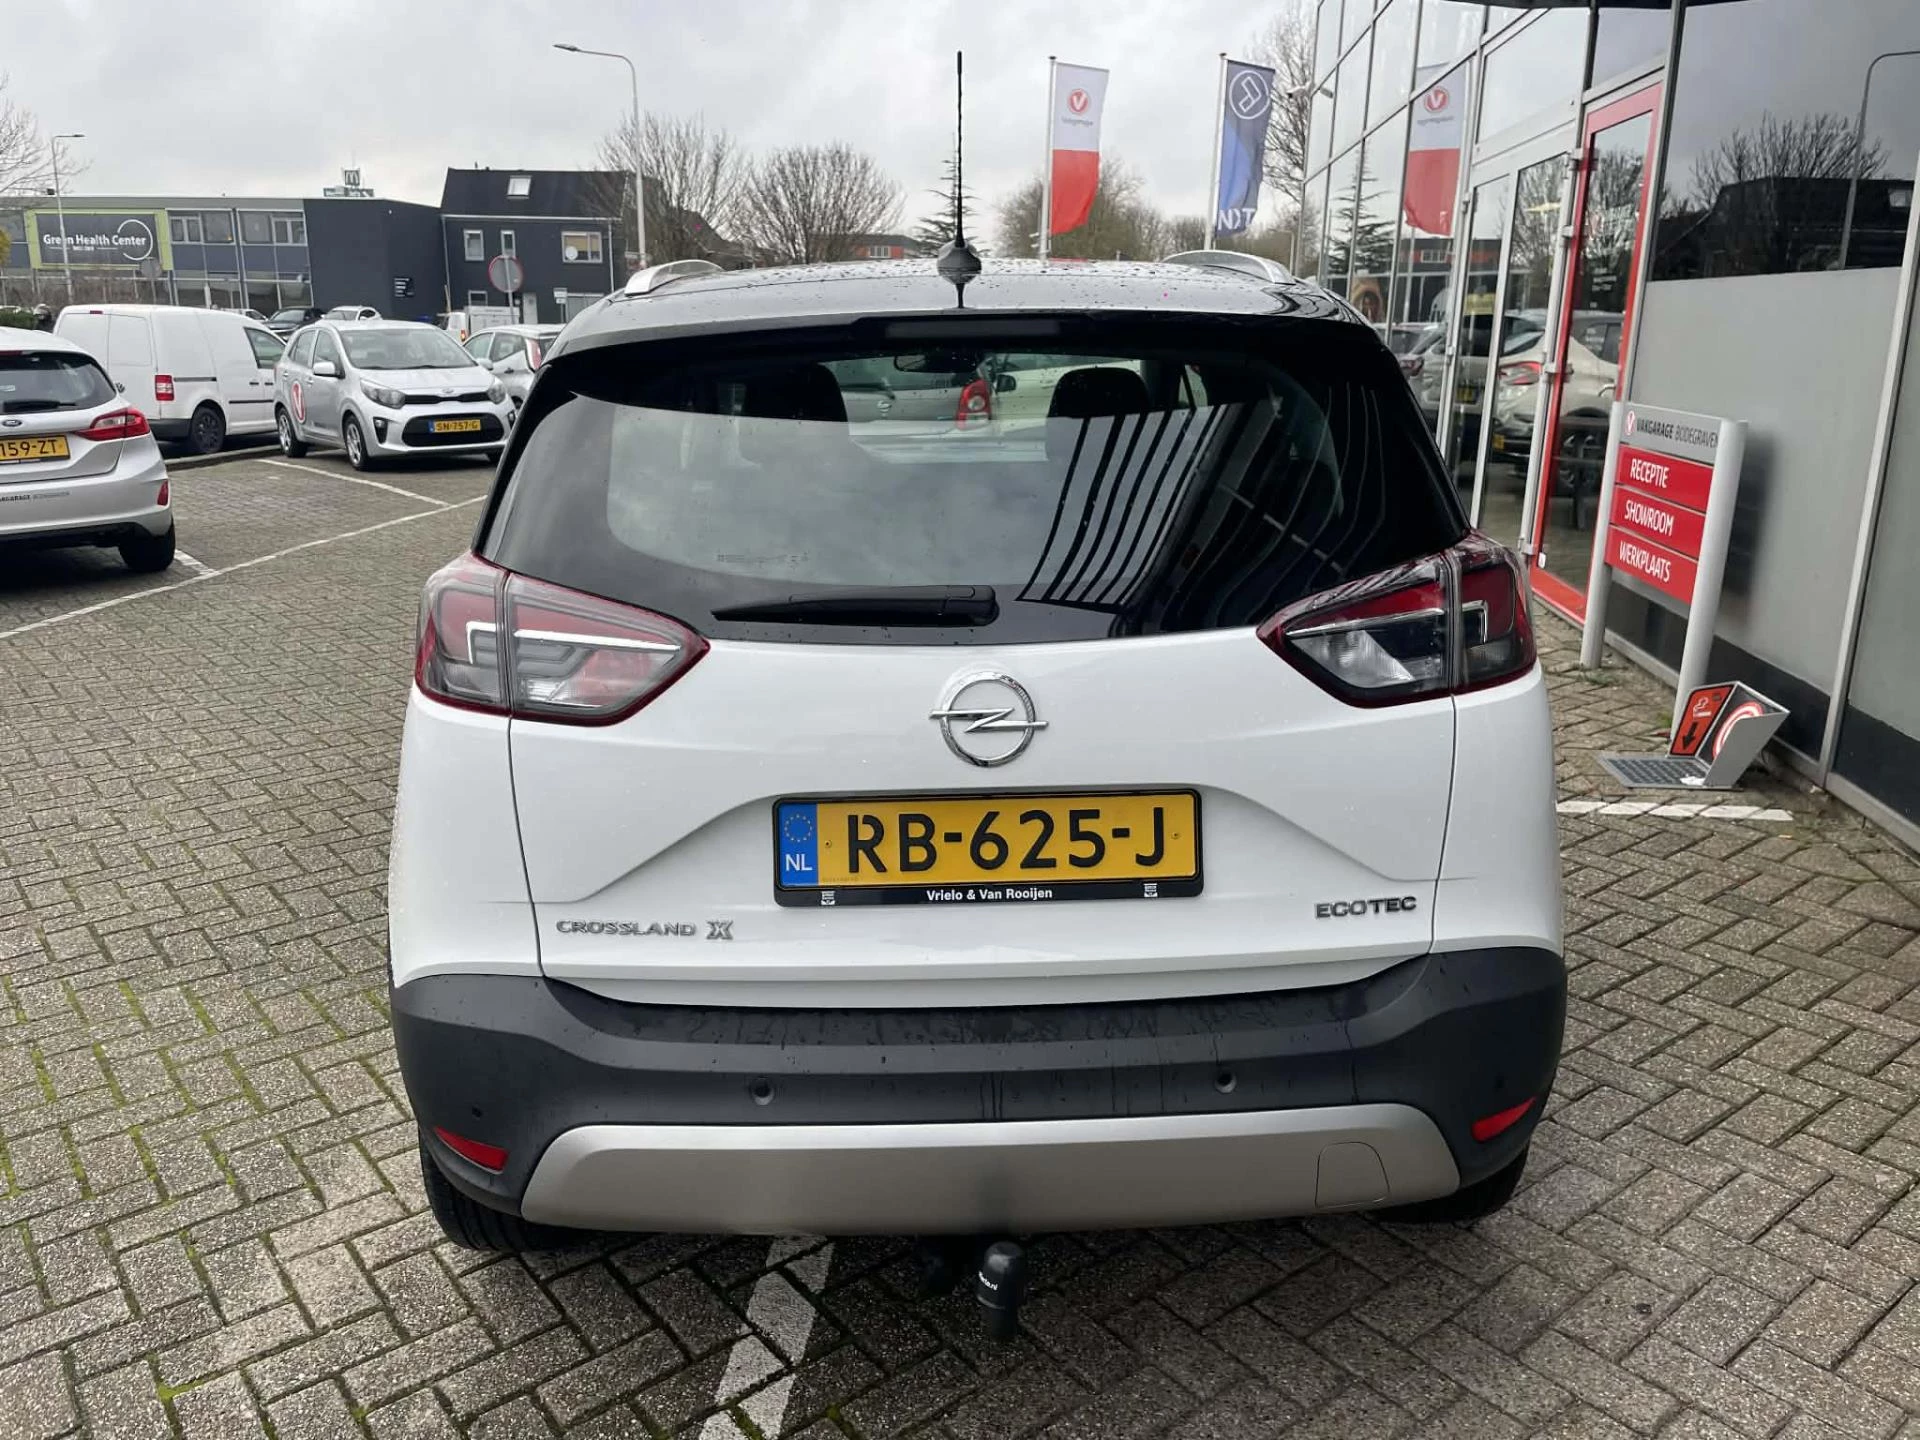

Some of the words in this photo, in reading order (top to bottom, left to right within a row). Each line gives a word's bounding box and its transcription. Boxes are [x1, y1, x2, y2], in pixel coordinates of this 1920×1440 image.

[43, 234, 74, 245] Gren
[75, 234, 110, 246] Health
[112, 234, 146, 246] Center
[1636, 418, 1674, 439] VAKGARAGE
[1674, 424, 1718, 448] BODEGRAVEN
[1630, 458, 1670, 489] RECEPTIE
[1624, 500, 1675, 537] SHOWROOM
[1619, 541, 1671, 583] WERKPLAATS
[847, 806, 1166, 874] RB-625-J
[784, 853, 813, 872] NL
[926, 889, 963, 901] Vrielo
[966, 889, 976, 900] &
[979, 888, 1003, 900] Van
[1005, 887, 1053, 901] Rooijen
[1315, 896, 1417, 919] ECOTEC
[556, 920, 697, 936] CROSSLAND
[706, 920, 734, 940] X
